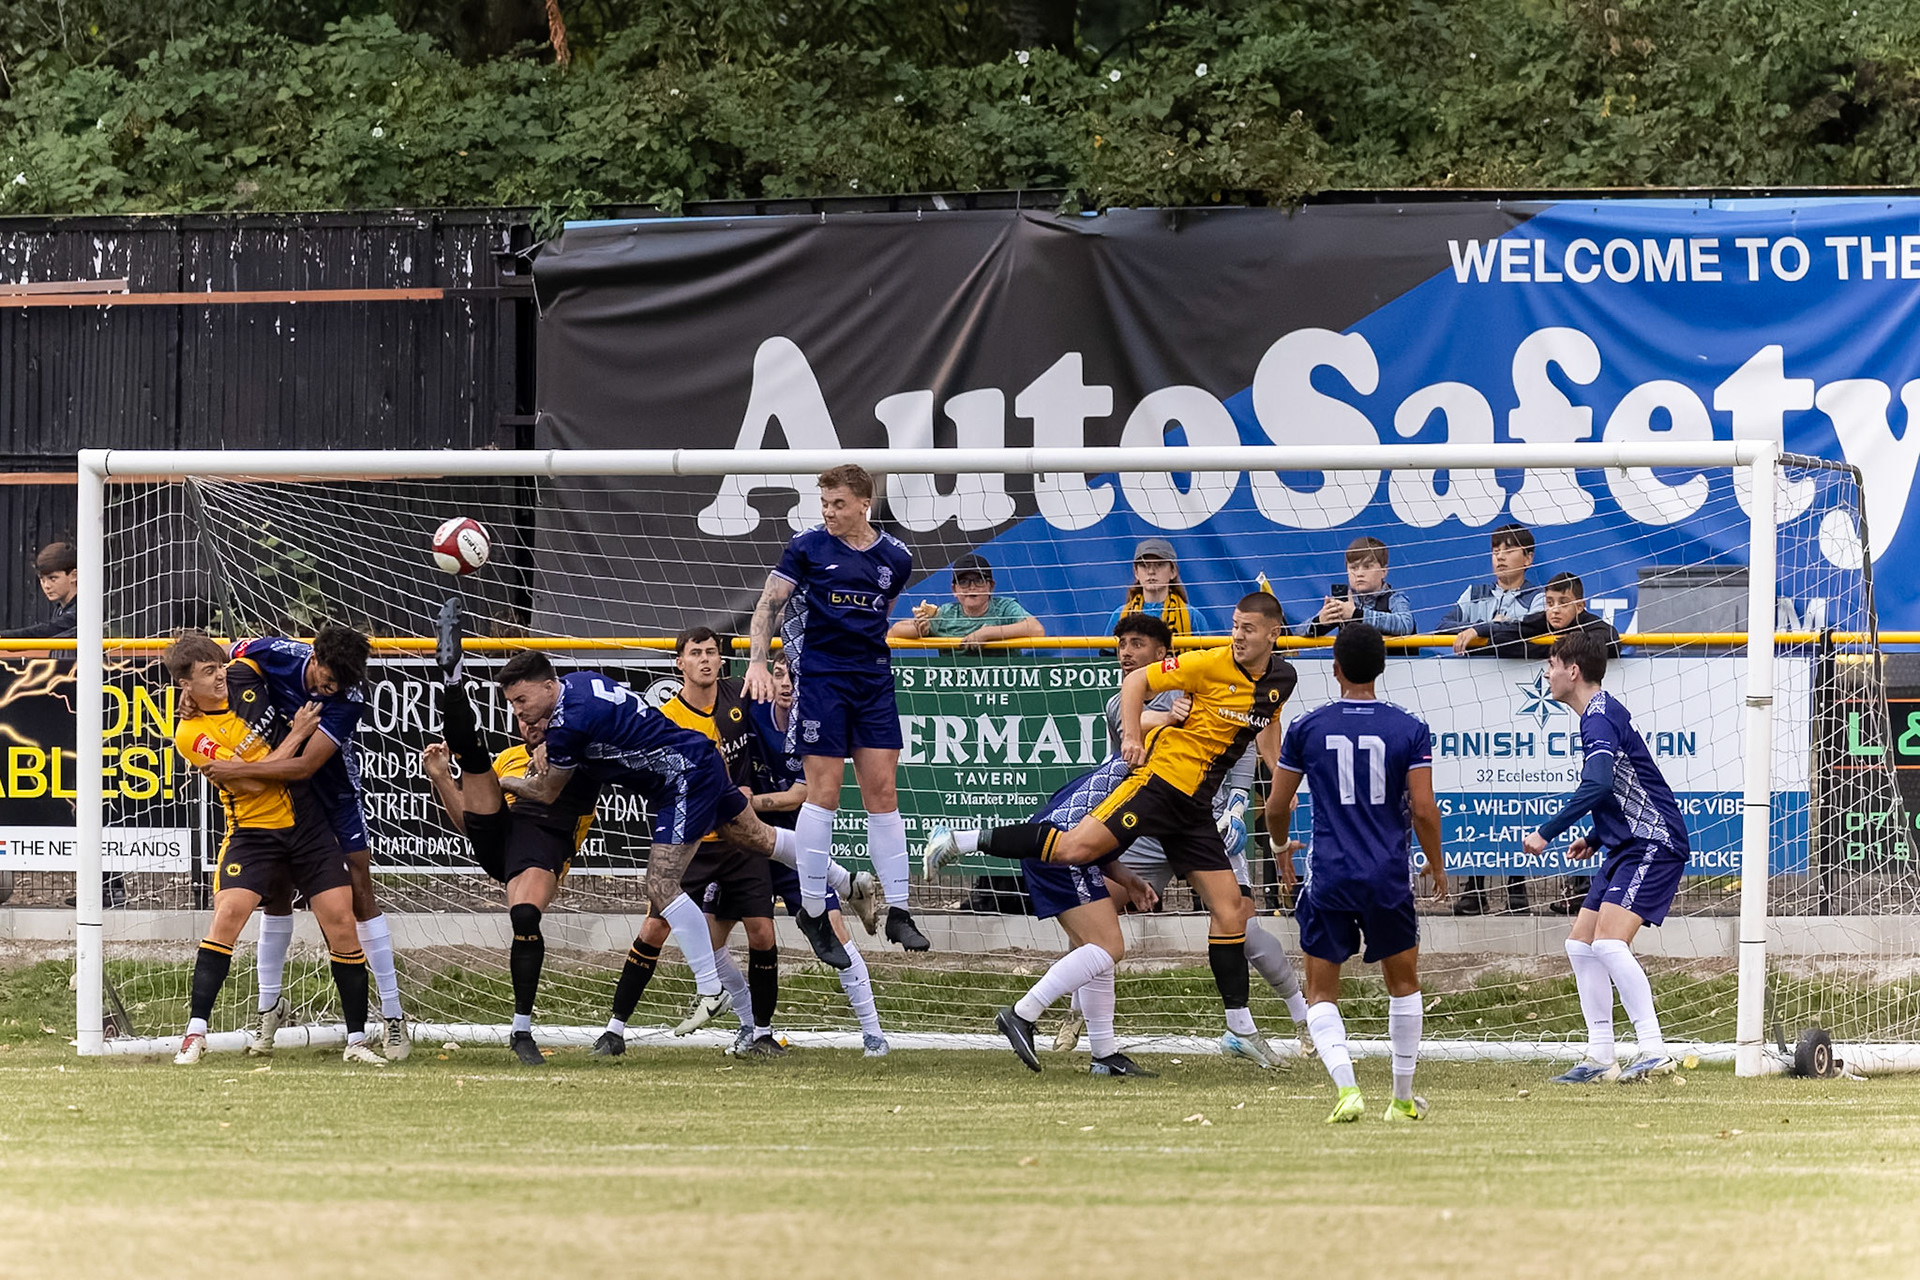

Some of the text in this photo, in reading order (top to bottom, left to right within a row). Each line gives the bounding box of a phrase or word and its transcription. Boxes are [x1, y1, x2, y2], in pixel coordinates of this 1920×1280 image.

[1447, 235, 1920, 283] WELCOME TO THE
[697, 326, 1920, 570] AutoSafety
[924, 668, 1040, 687] PREMIUM
[974, 693, 1009, 705] THE
[898, 712, 1111, 765] ERMAI
[0, 746, 174, 799] BLES!
[1326, 735, 1386, 805] 11
[1476, 769, 1494, 782] 32
[1497, 769, 1563, 782] Eccleston
[954, 772, 1027, 786] TAVERN
[365, 793, 431, 820] STREET
[945, 793, 1038, 805] 21 Market Place
[1473, 799, 1521, 816] WILD
[1704, 799, 1744, 815] VIBE
[832, 813, 869, 830] ixirs
[1455, 826, 1476, 842] 12
[10, 840, 45, 855] THE
[379, 837, 424, 855] MATCH
[428, 837, 461, 855] DAYS
[1445, 852, 1509, 868] MATCH
[1513, 852, 1559, 868] DAYS
